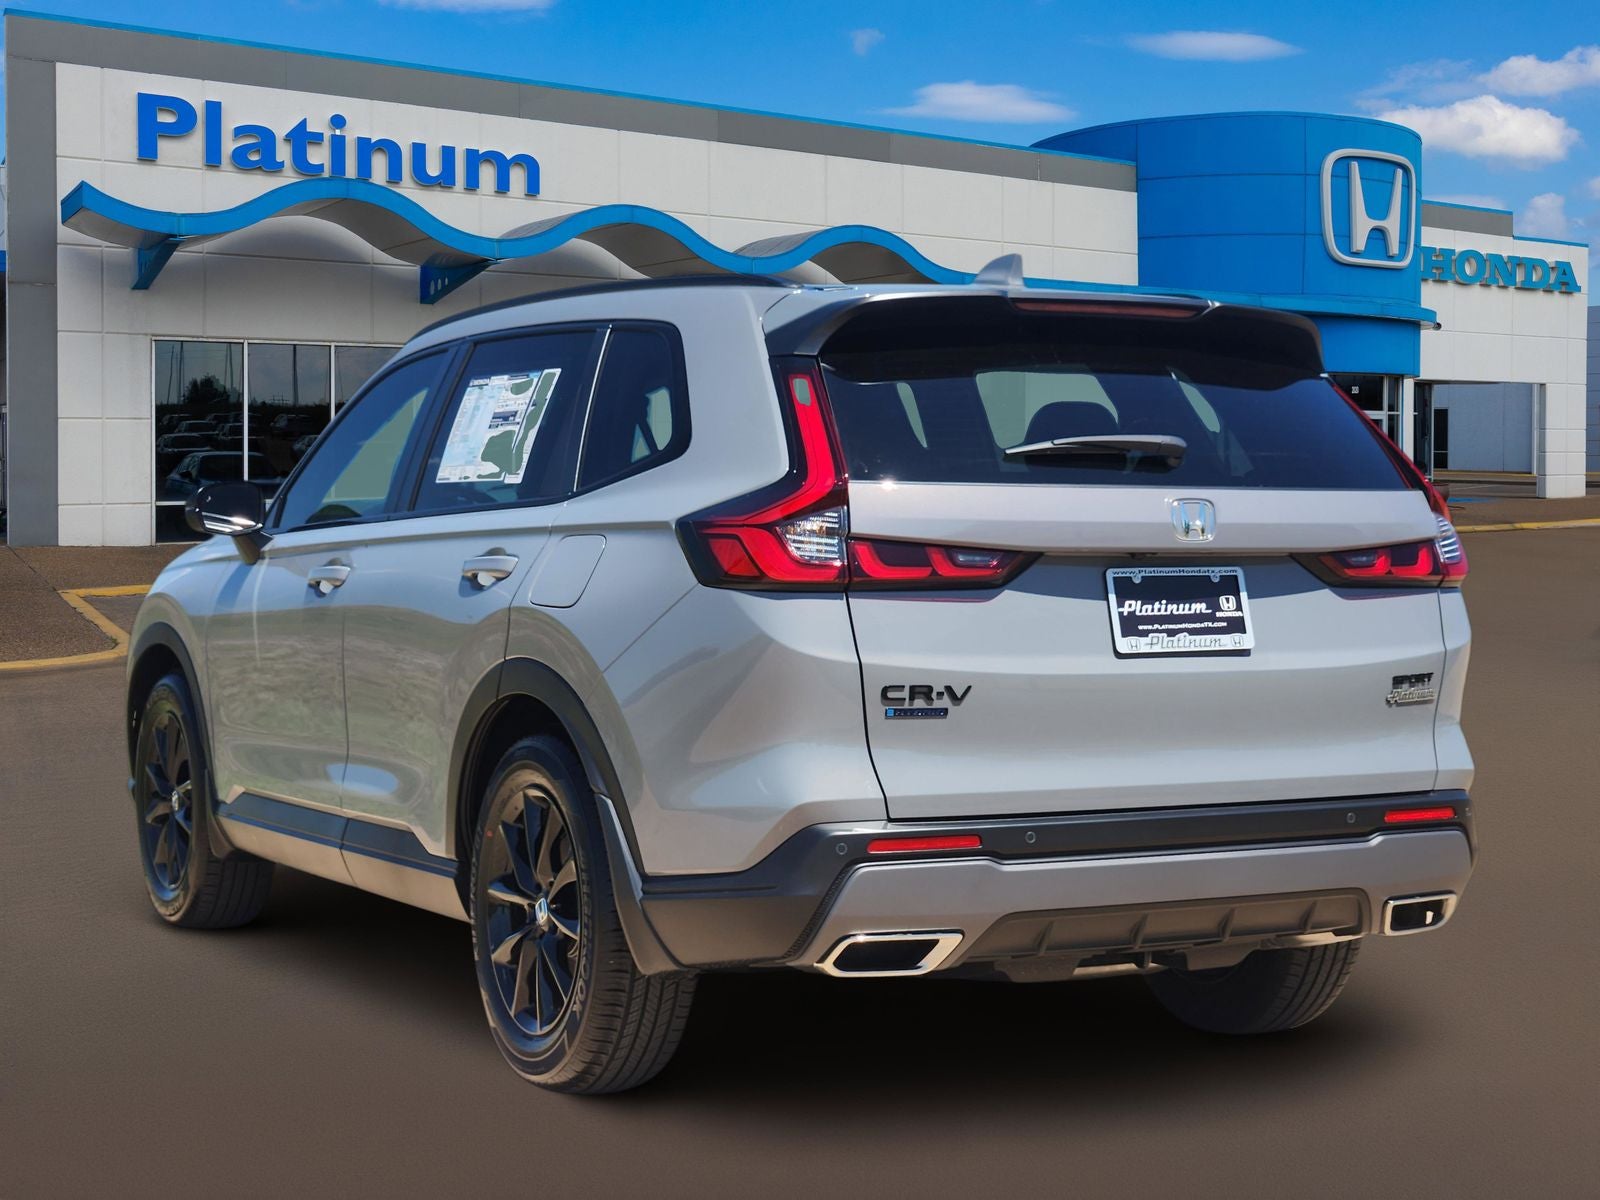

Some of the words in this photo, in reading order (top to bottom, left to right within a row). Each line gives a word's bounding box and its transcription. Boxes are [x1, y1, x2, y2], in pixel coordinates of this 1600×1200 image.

[137, 92, 541, 197] Platinum
[1420, 246, 1581, 293] HONDA
[1118, 600, 1212, 616] Platinum
[1144, 634, 1227, 650] Platinum
[881, 684, 973, 704] CR-V
